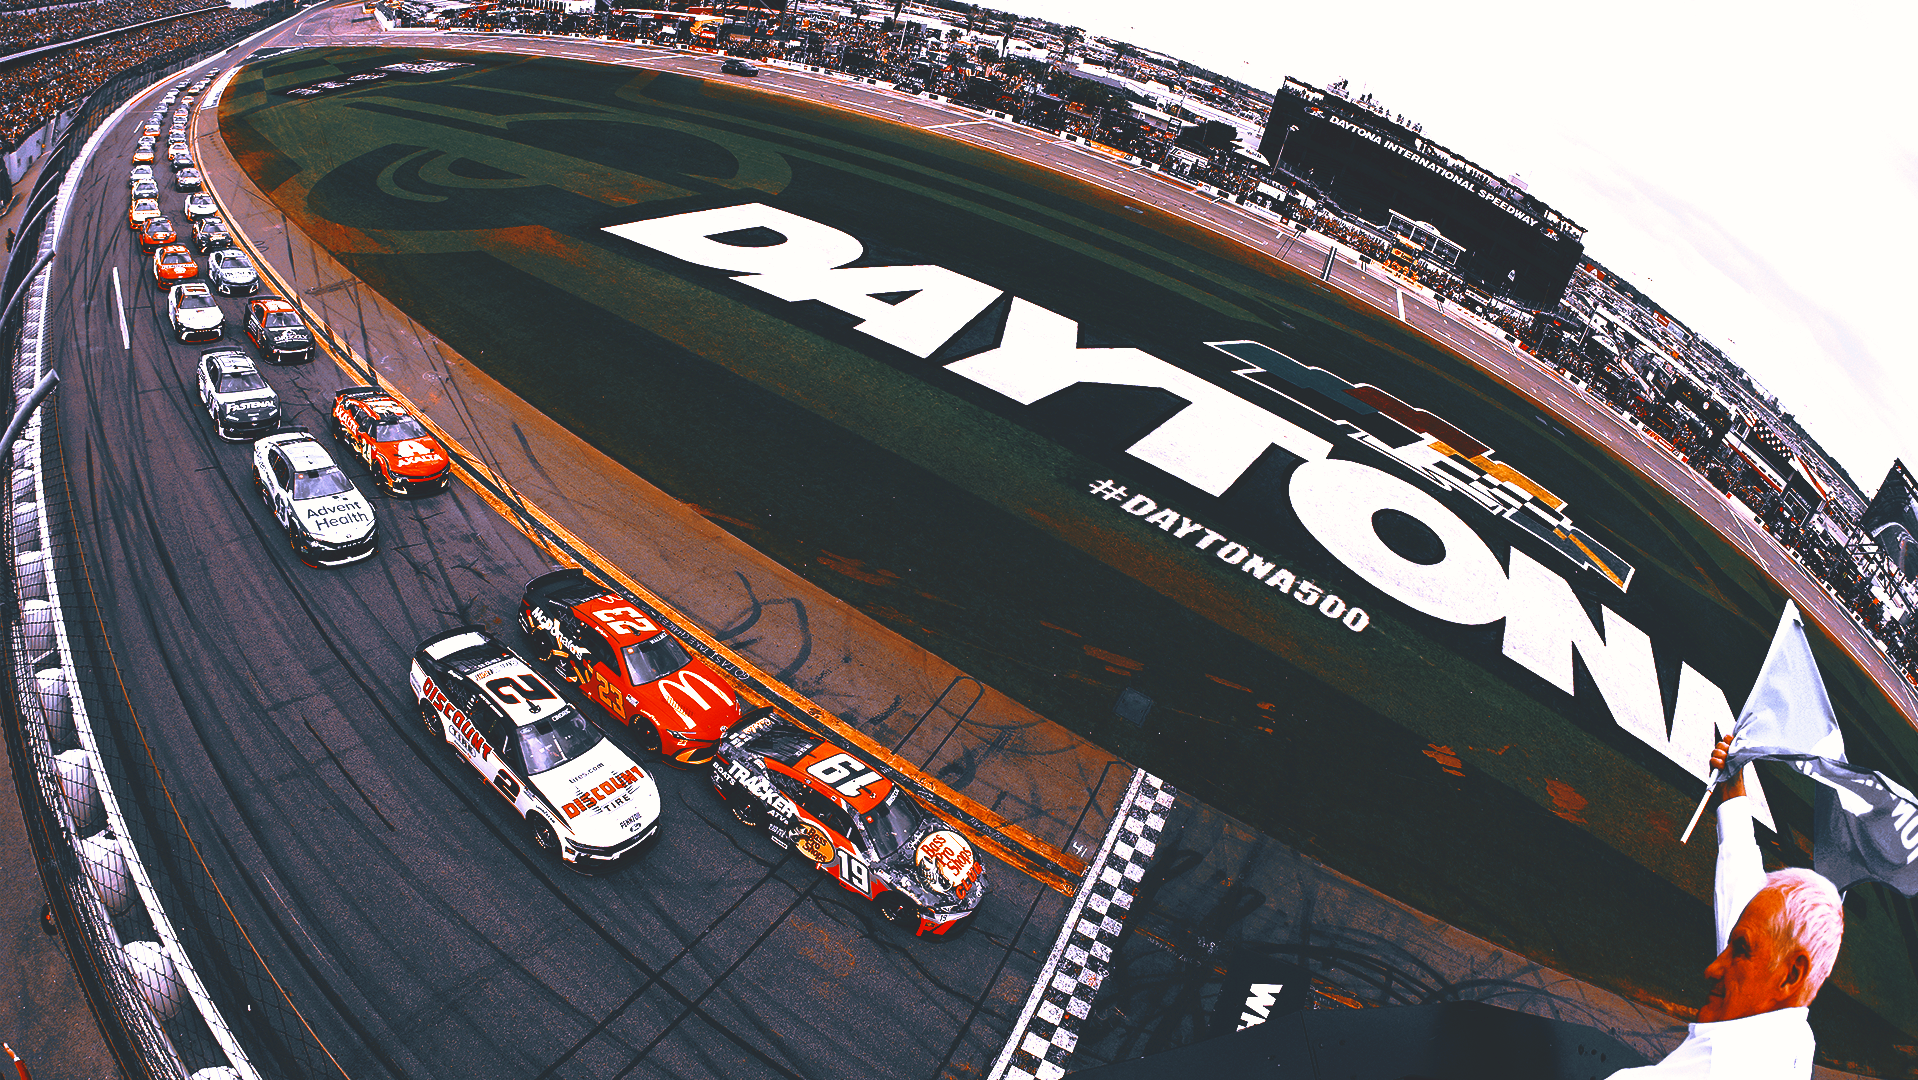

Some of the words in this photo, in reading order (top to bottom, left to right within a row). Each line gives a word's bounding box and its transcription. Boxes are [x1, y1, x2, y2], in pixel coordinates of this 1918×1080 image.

[1329, 115, 1382, 145] DAYTONA
[1383, 140, 1475, 193] INTERNATIONAL
[1477, 189, 1539, 227] SPEEDWAY
[398, 454, 443, 467] AXALTA
[307, 501, 362, 519] Advent
[315, 512, 370, 531] Health
[600, 202, 1777, 833] DAYTONA
[1089, 479, 1370, 632] #DAYTONA500
[485, 673, 558, 705] 2
[596, 672, 626, 719] 23
[422, 677, 493, 762] DISCOUNT
[493, 769, 520, 803] 2
[569, 762, 605, 784] tires.com
[712, 762, 736, 785] BOATS
[561, 766, 645, 819] DISCOUNT
[604, 794, 630, 811] TIRE
[728, 759, 797, 819] TRACKER
[802, 841, 827, 863] Shops
[807, 827, 828, 846] Bass
[921, 834, 946, 858] Bass
[838, 850, 869, 893] 19
[935, 847, 955, 867] Pro
[947, 847, 972, 877] Shops
[955, 861, 983, 899] CLUB
